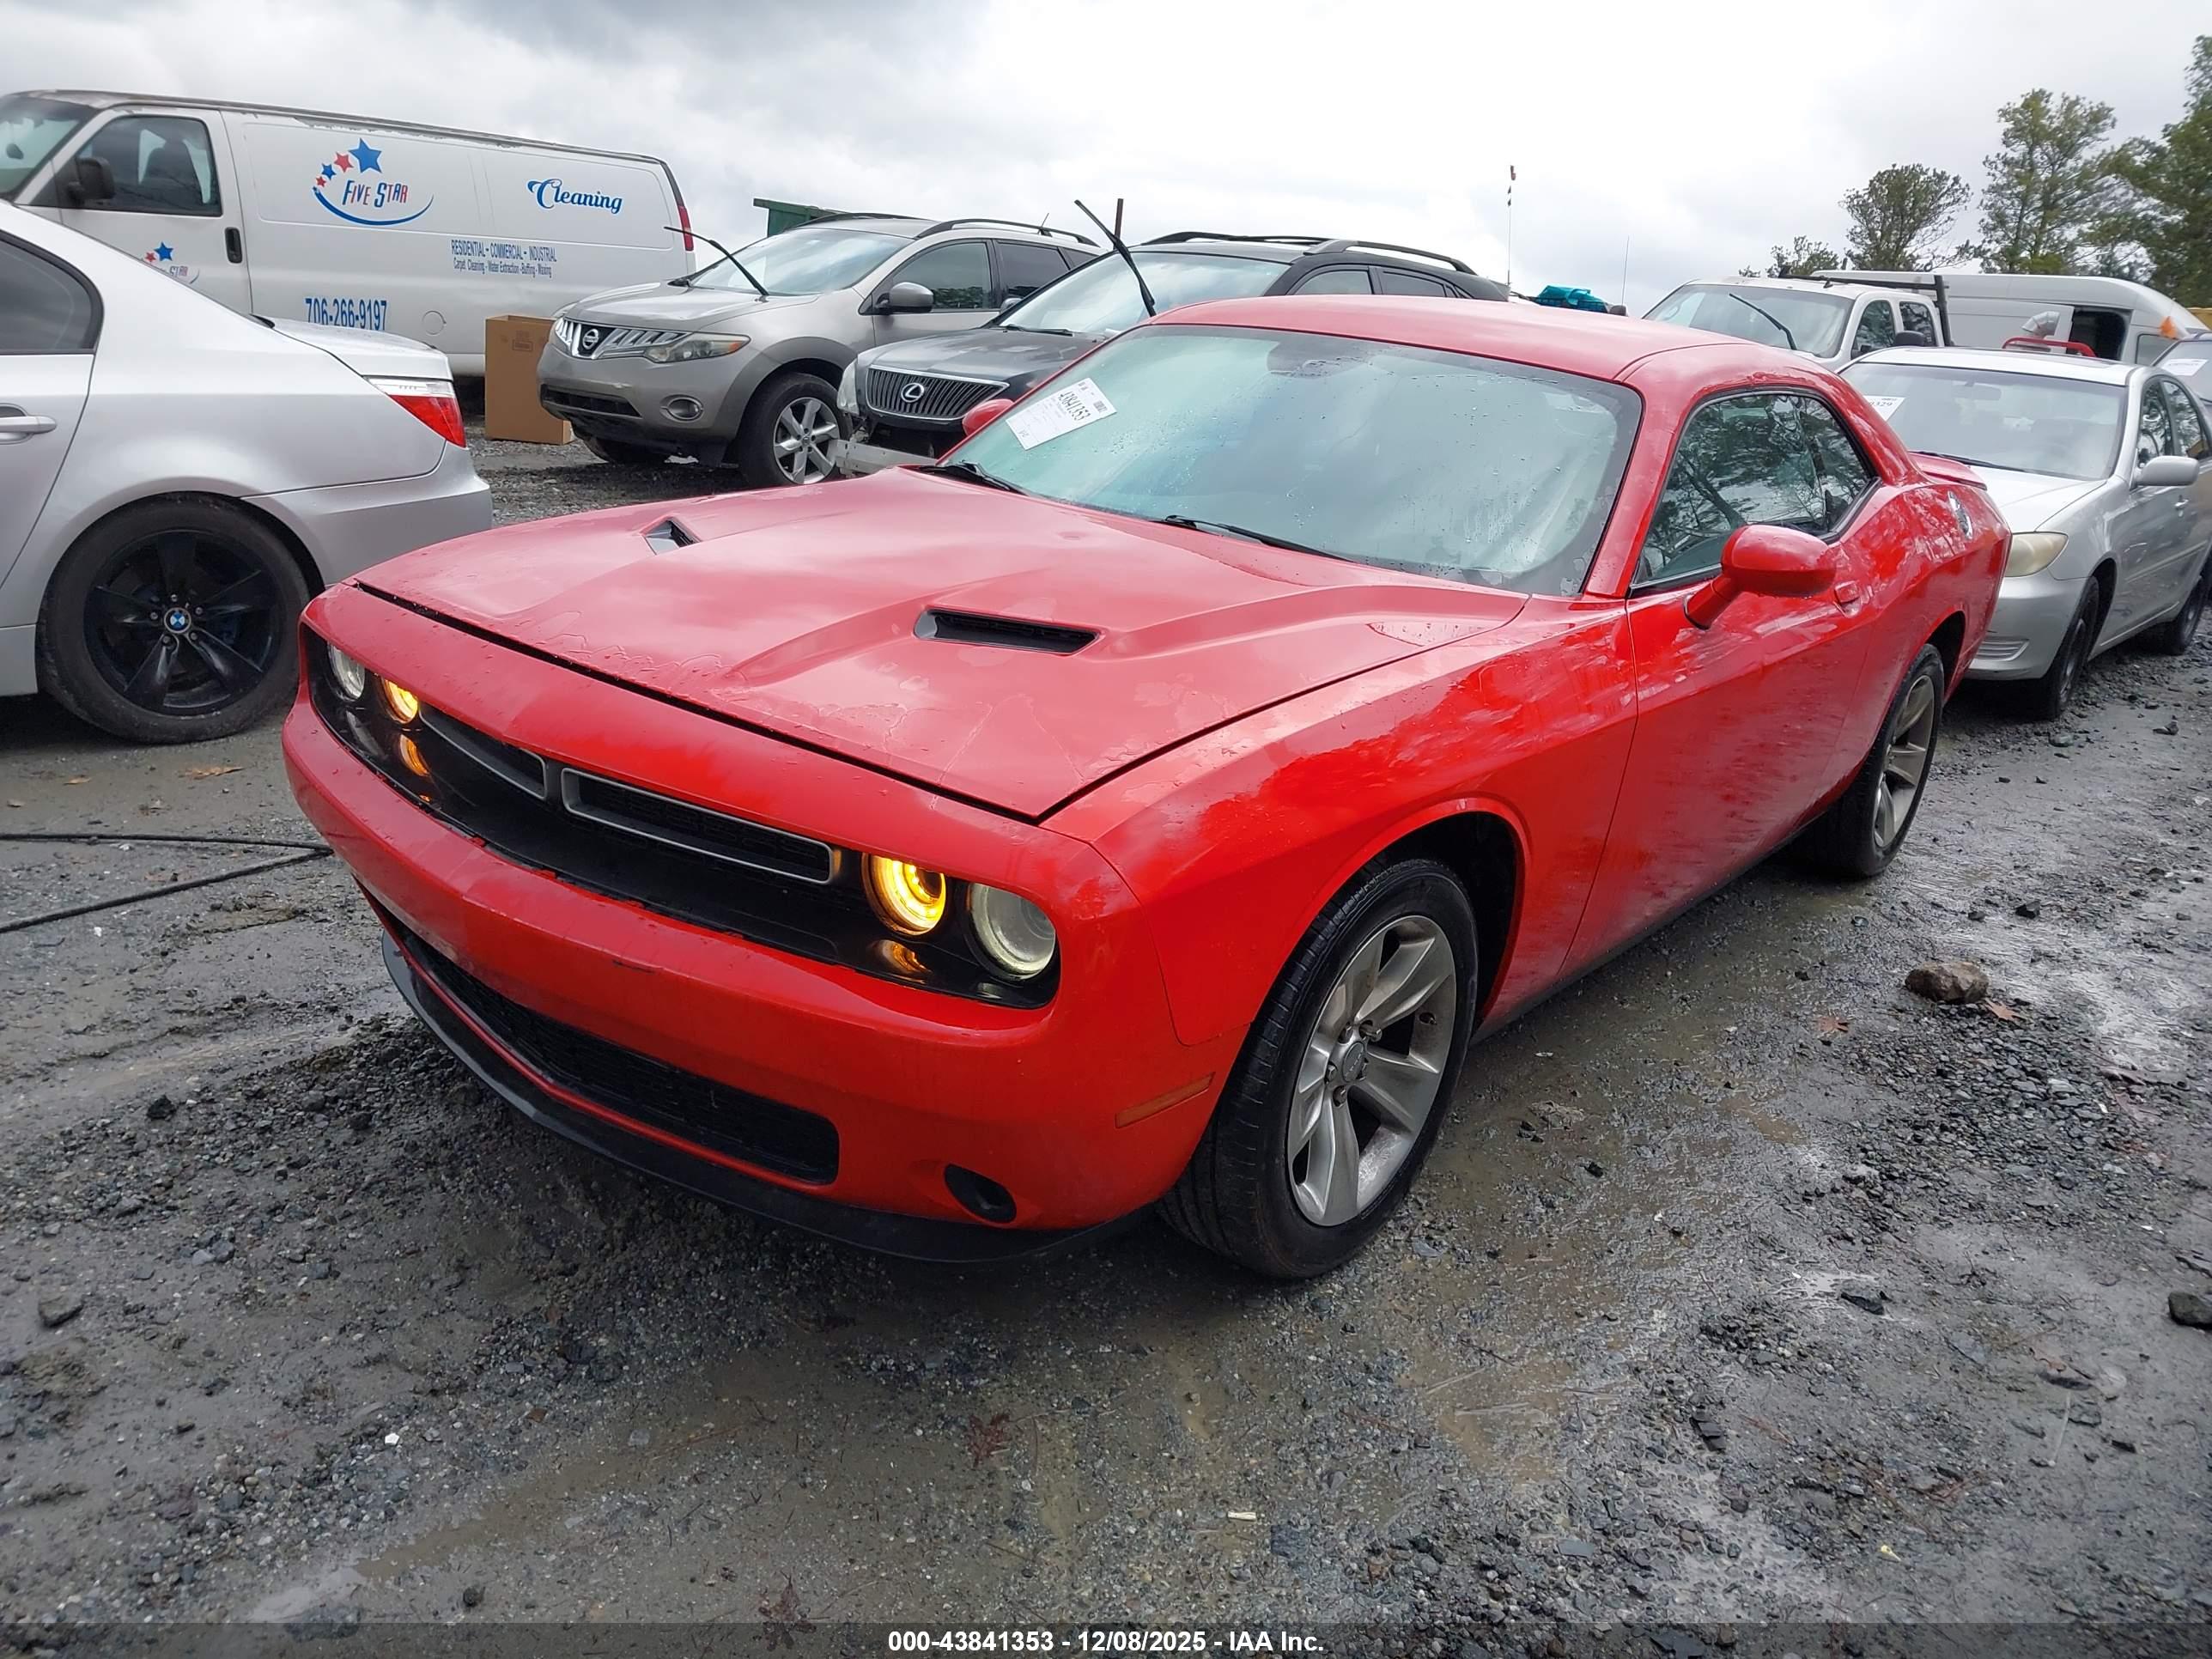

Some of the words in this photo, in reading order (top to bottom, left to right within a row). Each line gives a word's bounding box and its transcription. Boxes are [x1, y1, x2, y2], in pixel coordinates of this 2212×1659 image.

[374, 182, 409, 208] STAR
[527, 179, 623, 214] Cleaning
[451, 240, 485, 257] RESIDENTIAL
[489, 242, 523, 260] COMMERCIAL
[529, 246, 557, 262] INDUSTRIAL
[453, 257, 466, 271] Carpet
[467, 259, 485, 275] Cleaning
[488, 261, 500, 273] Water
[500, 261, 520, 274] Extraction
[305, 298, 387, 331] 706-266-9197
[1058, 391, 1091, 421] 43841353
